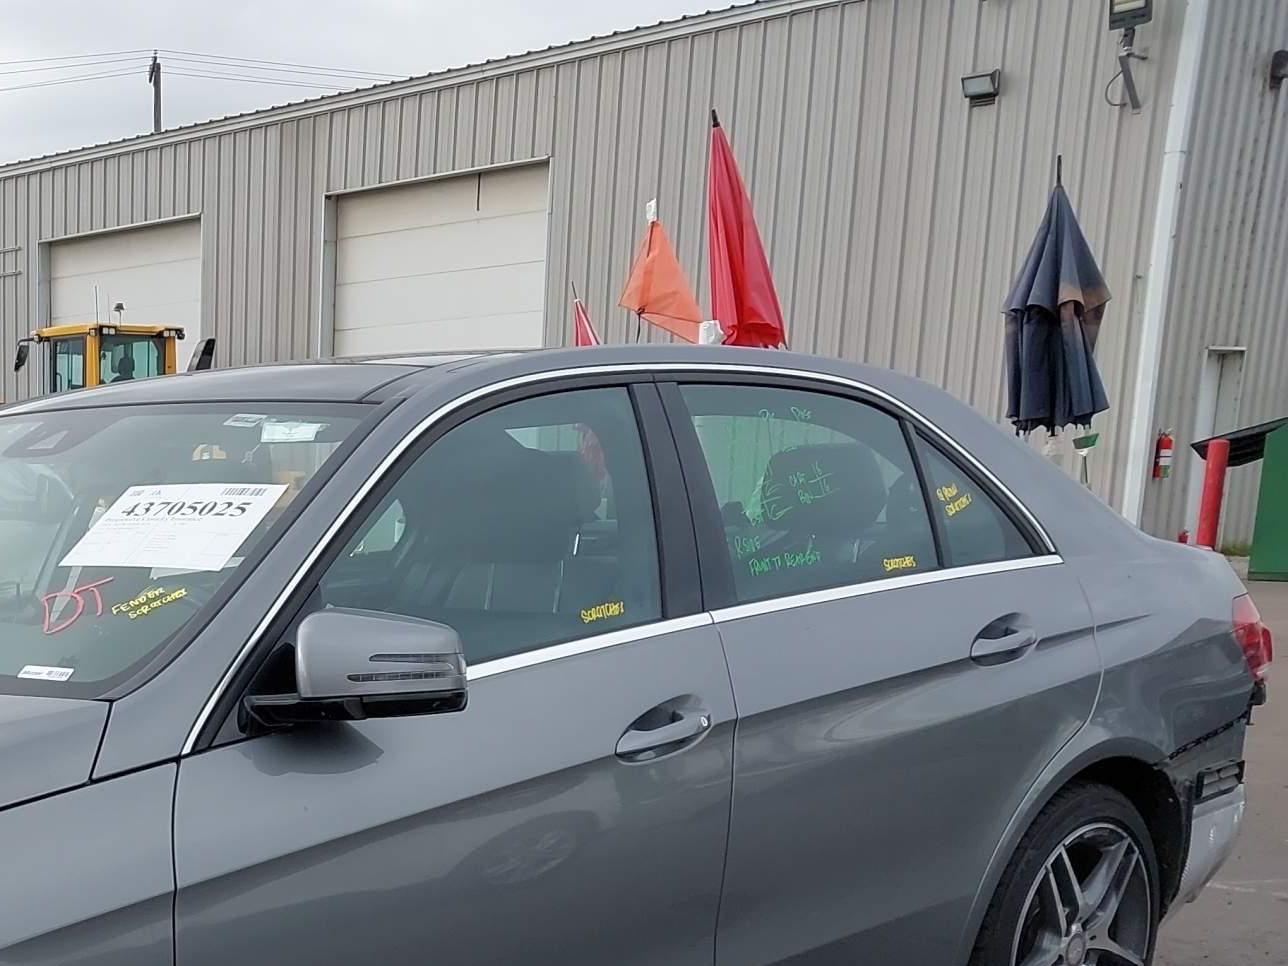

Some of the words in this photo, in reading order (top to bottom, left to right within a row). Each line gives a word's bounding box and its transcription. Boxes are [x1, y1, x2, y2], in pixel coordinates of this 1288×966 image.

[121, 501, 252, 518] 43705025
[41, 576, 114, 634] DT
[111, 586, 165, 616] FENDER
